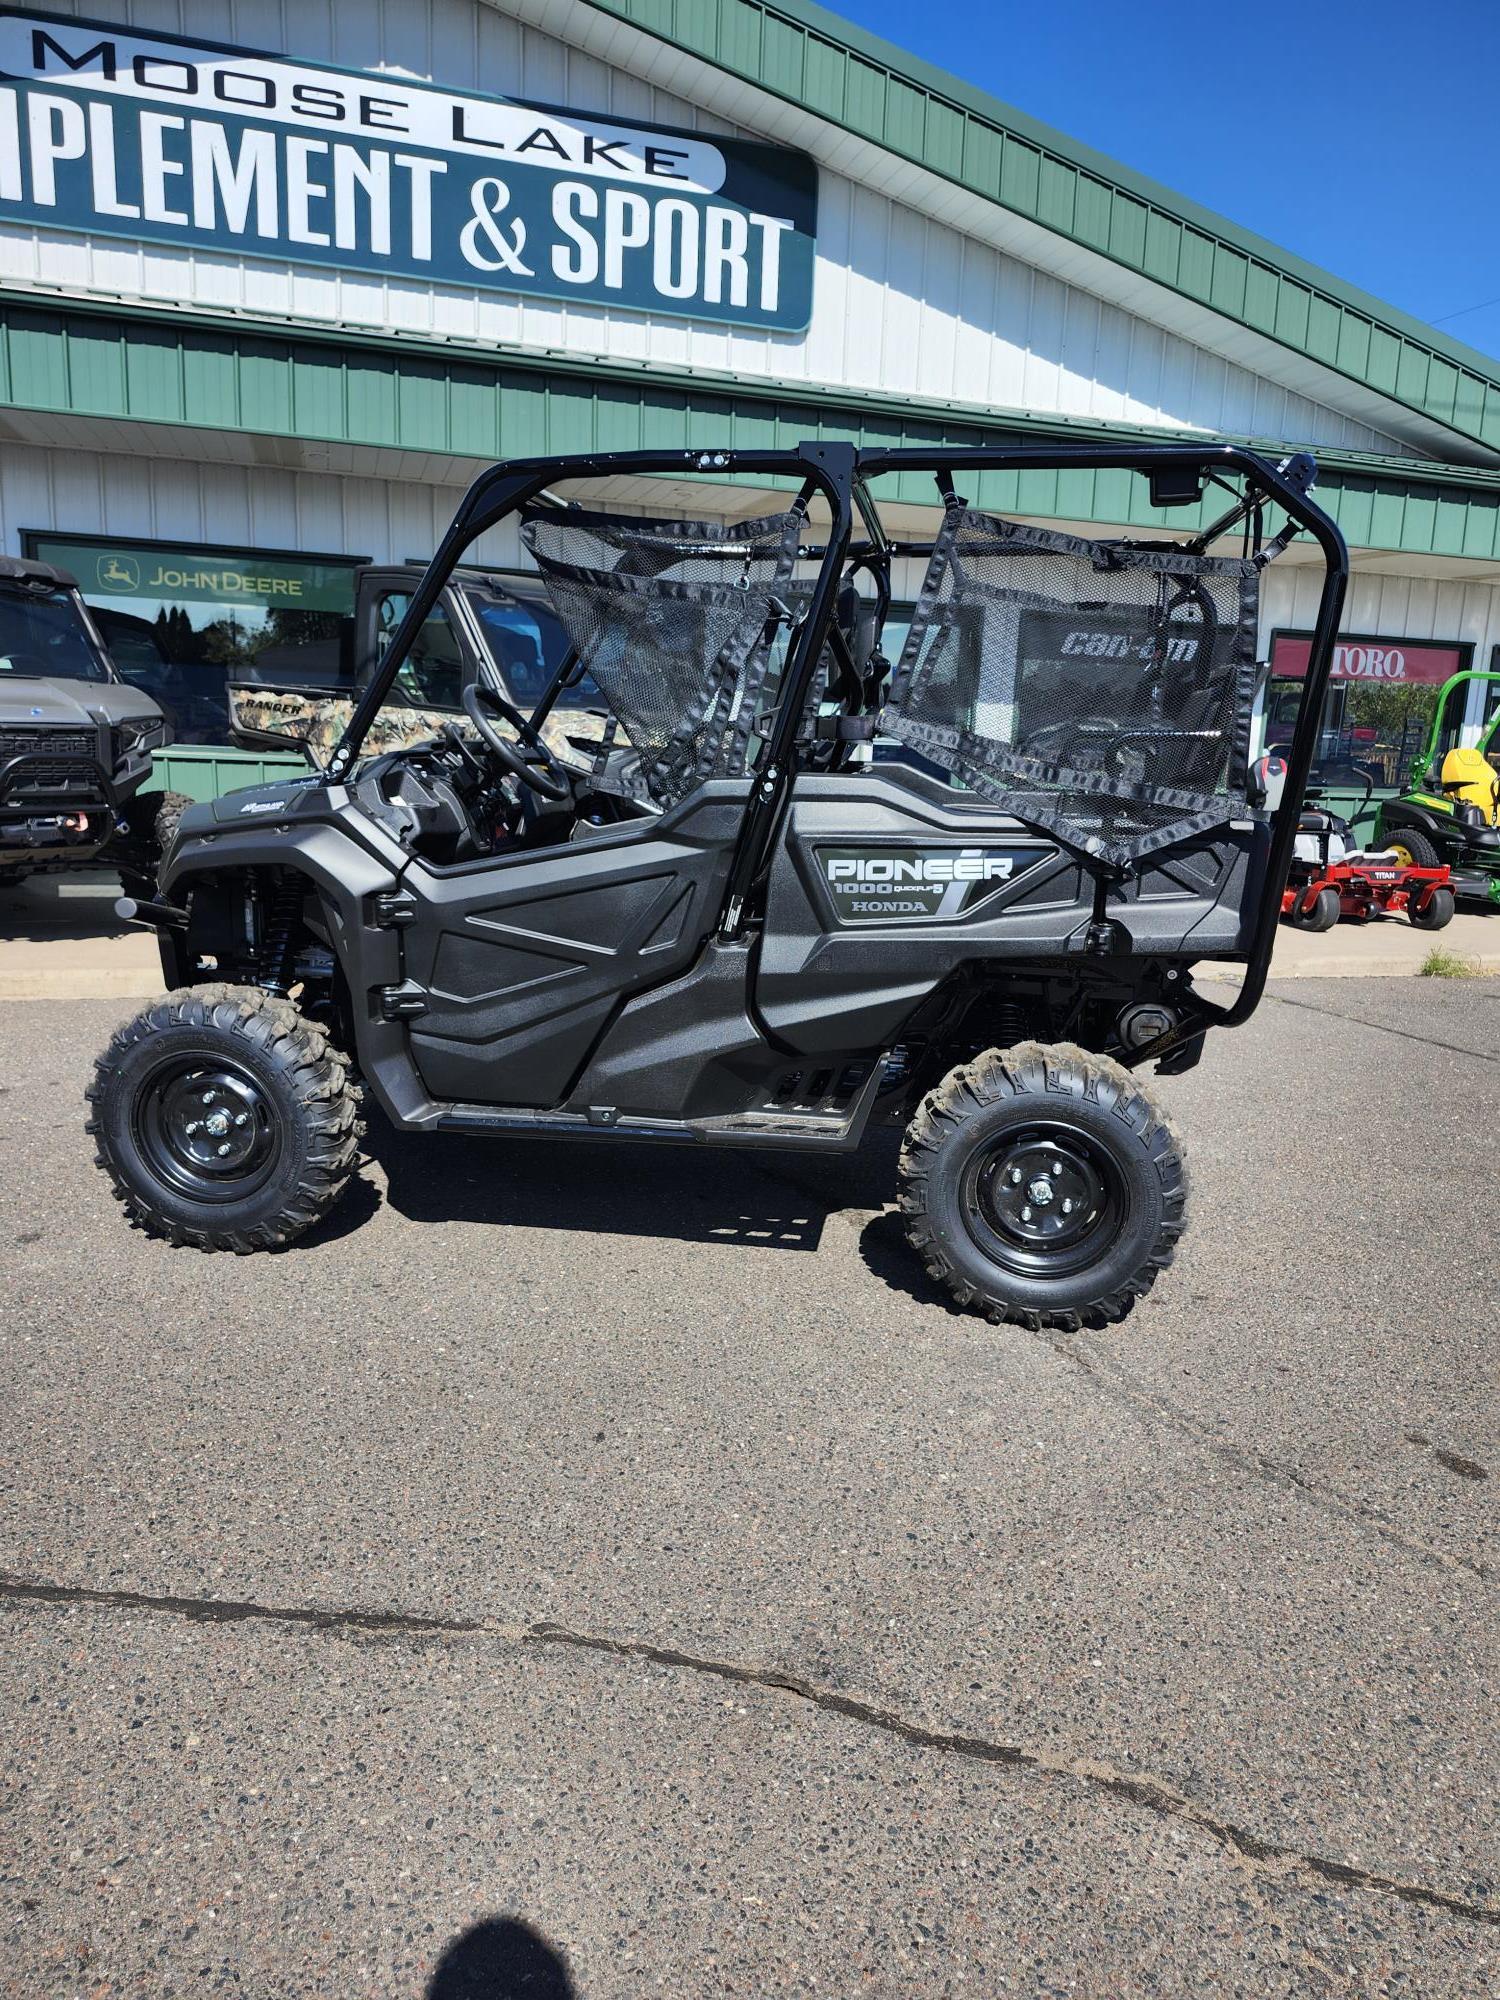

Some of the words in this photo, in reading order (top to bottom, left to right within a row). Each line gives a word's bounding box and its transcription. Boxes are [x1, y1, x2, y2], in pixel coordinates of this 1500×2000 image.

[32, 29, 410, 133] MOOSE
[452, 105, 690, 181] LAKE
[0, 86, 448, 262] PLEMENT
[459, 177, 536, 277] &
[551, 181, 795, 312] SPORT
[149, 566, 217, 590] JOHN
[222, 571, 303, 596] DEERE
[245, 698, 302, 715] RANGER
[828, 858, 1013, 880] PIONEER
[1374, 871, 1396, 880] TITAN
[834, 883, 892, 893] 1000
[851, 901, 929, 912] HONDA
